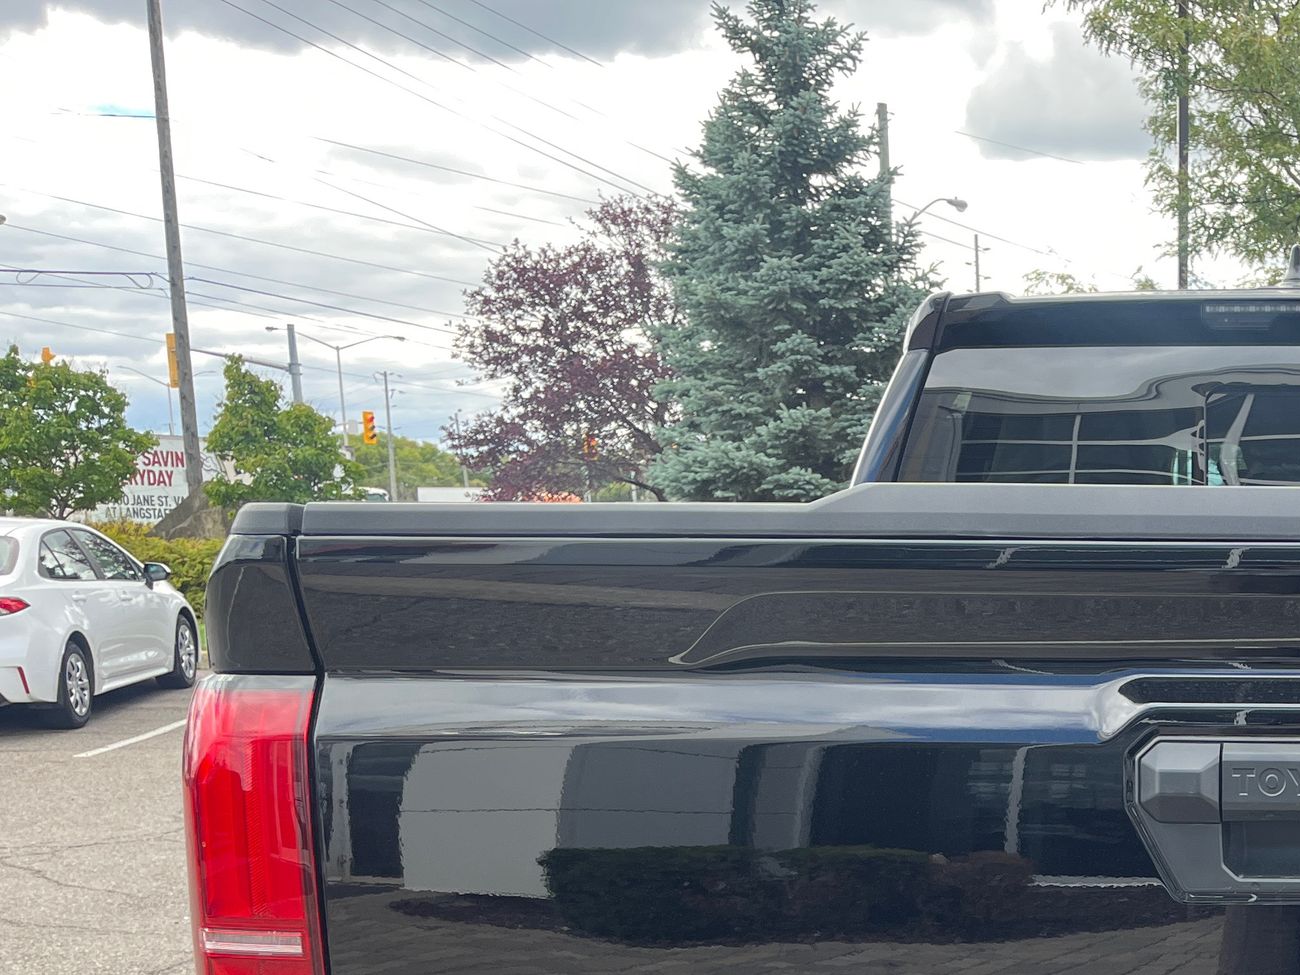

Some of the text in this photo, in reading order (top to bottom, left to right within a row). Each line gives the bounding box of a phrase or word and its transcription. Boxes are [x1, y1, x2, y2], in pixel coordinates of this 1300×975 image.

[142, 450, 185, 468] SAVIN
[121, 469, 174, 487] RYDAY
[131, 494, 155, 507] JANE
[157, 495, 172, 507] ST.
[105, 506, 117, 518] AT
